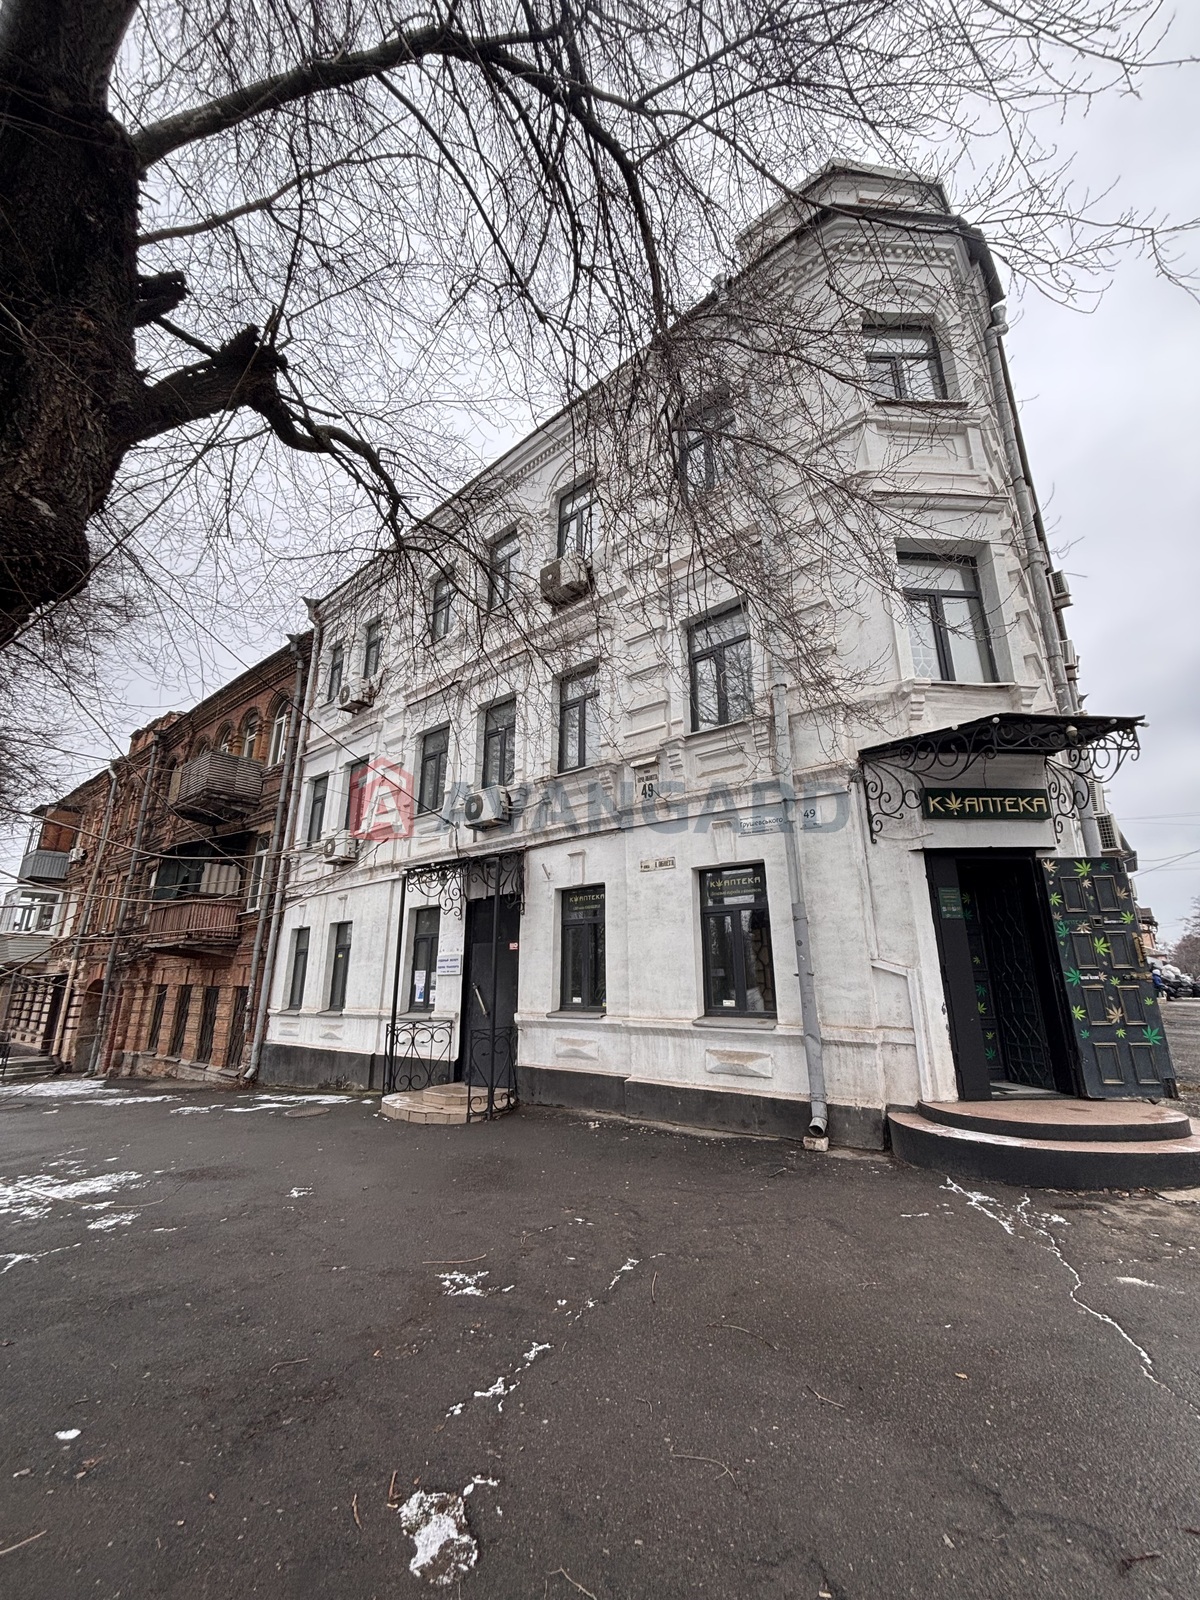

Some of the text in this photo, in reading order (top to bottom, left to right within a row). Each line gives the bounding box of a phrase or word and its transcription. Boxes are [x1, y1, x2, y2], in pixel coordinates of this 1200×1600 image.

[641, 782, 654, 799] 49
[803, 808, 816, 818] 49
[739, 817, 783, 828] Грушевського
